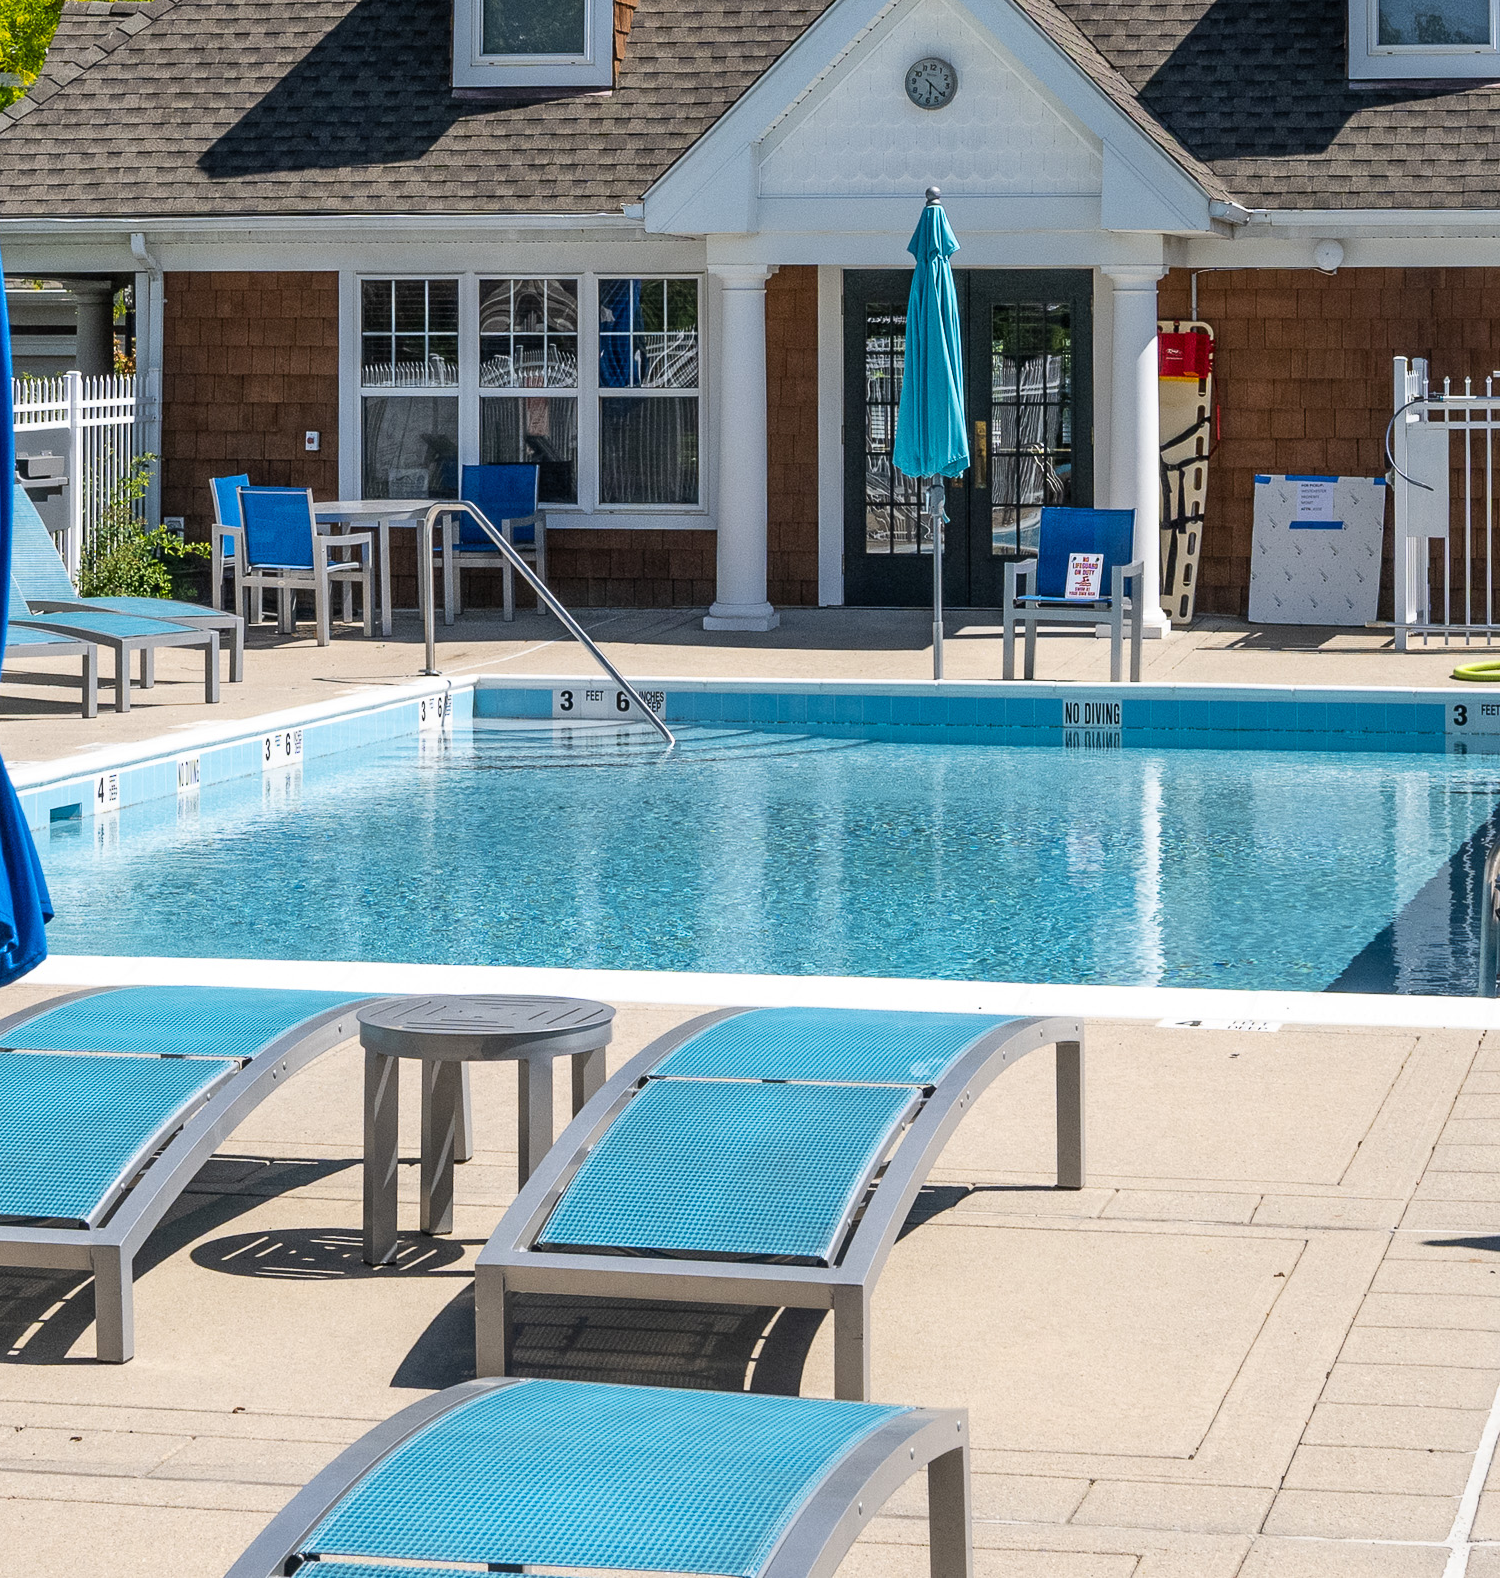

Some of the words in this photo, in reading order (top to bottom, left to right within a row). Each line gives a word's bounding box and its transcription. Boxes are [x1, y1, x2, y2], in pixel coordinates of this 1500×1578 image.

[421, 700, 426, 722] 3
[437, 697, 442, 718] 6
[560, 690, 574, 711] 3
[586, 690, 604, 701] FEET
[616, 691, 630, 712] 6
[1065, 702, 1080, 724] NO
[1084, 702, 1120, 725] DIVING
[1453, 704, 1468, 726] 3
[1481, 704, 1500, 716] FEET
[265, 738, 271, 761] 3
[285, 733, 291, 756] 6
[98, 777, 104, 803] 4
